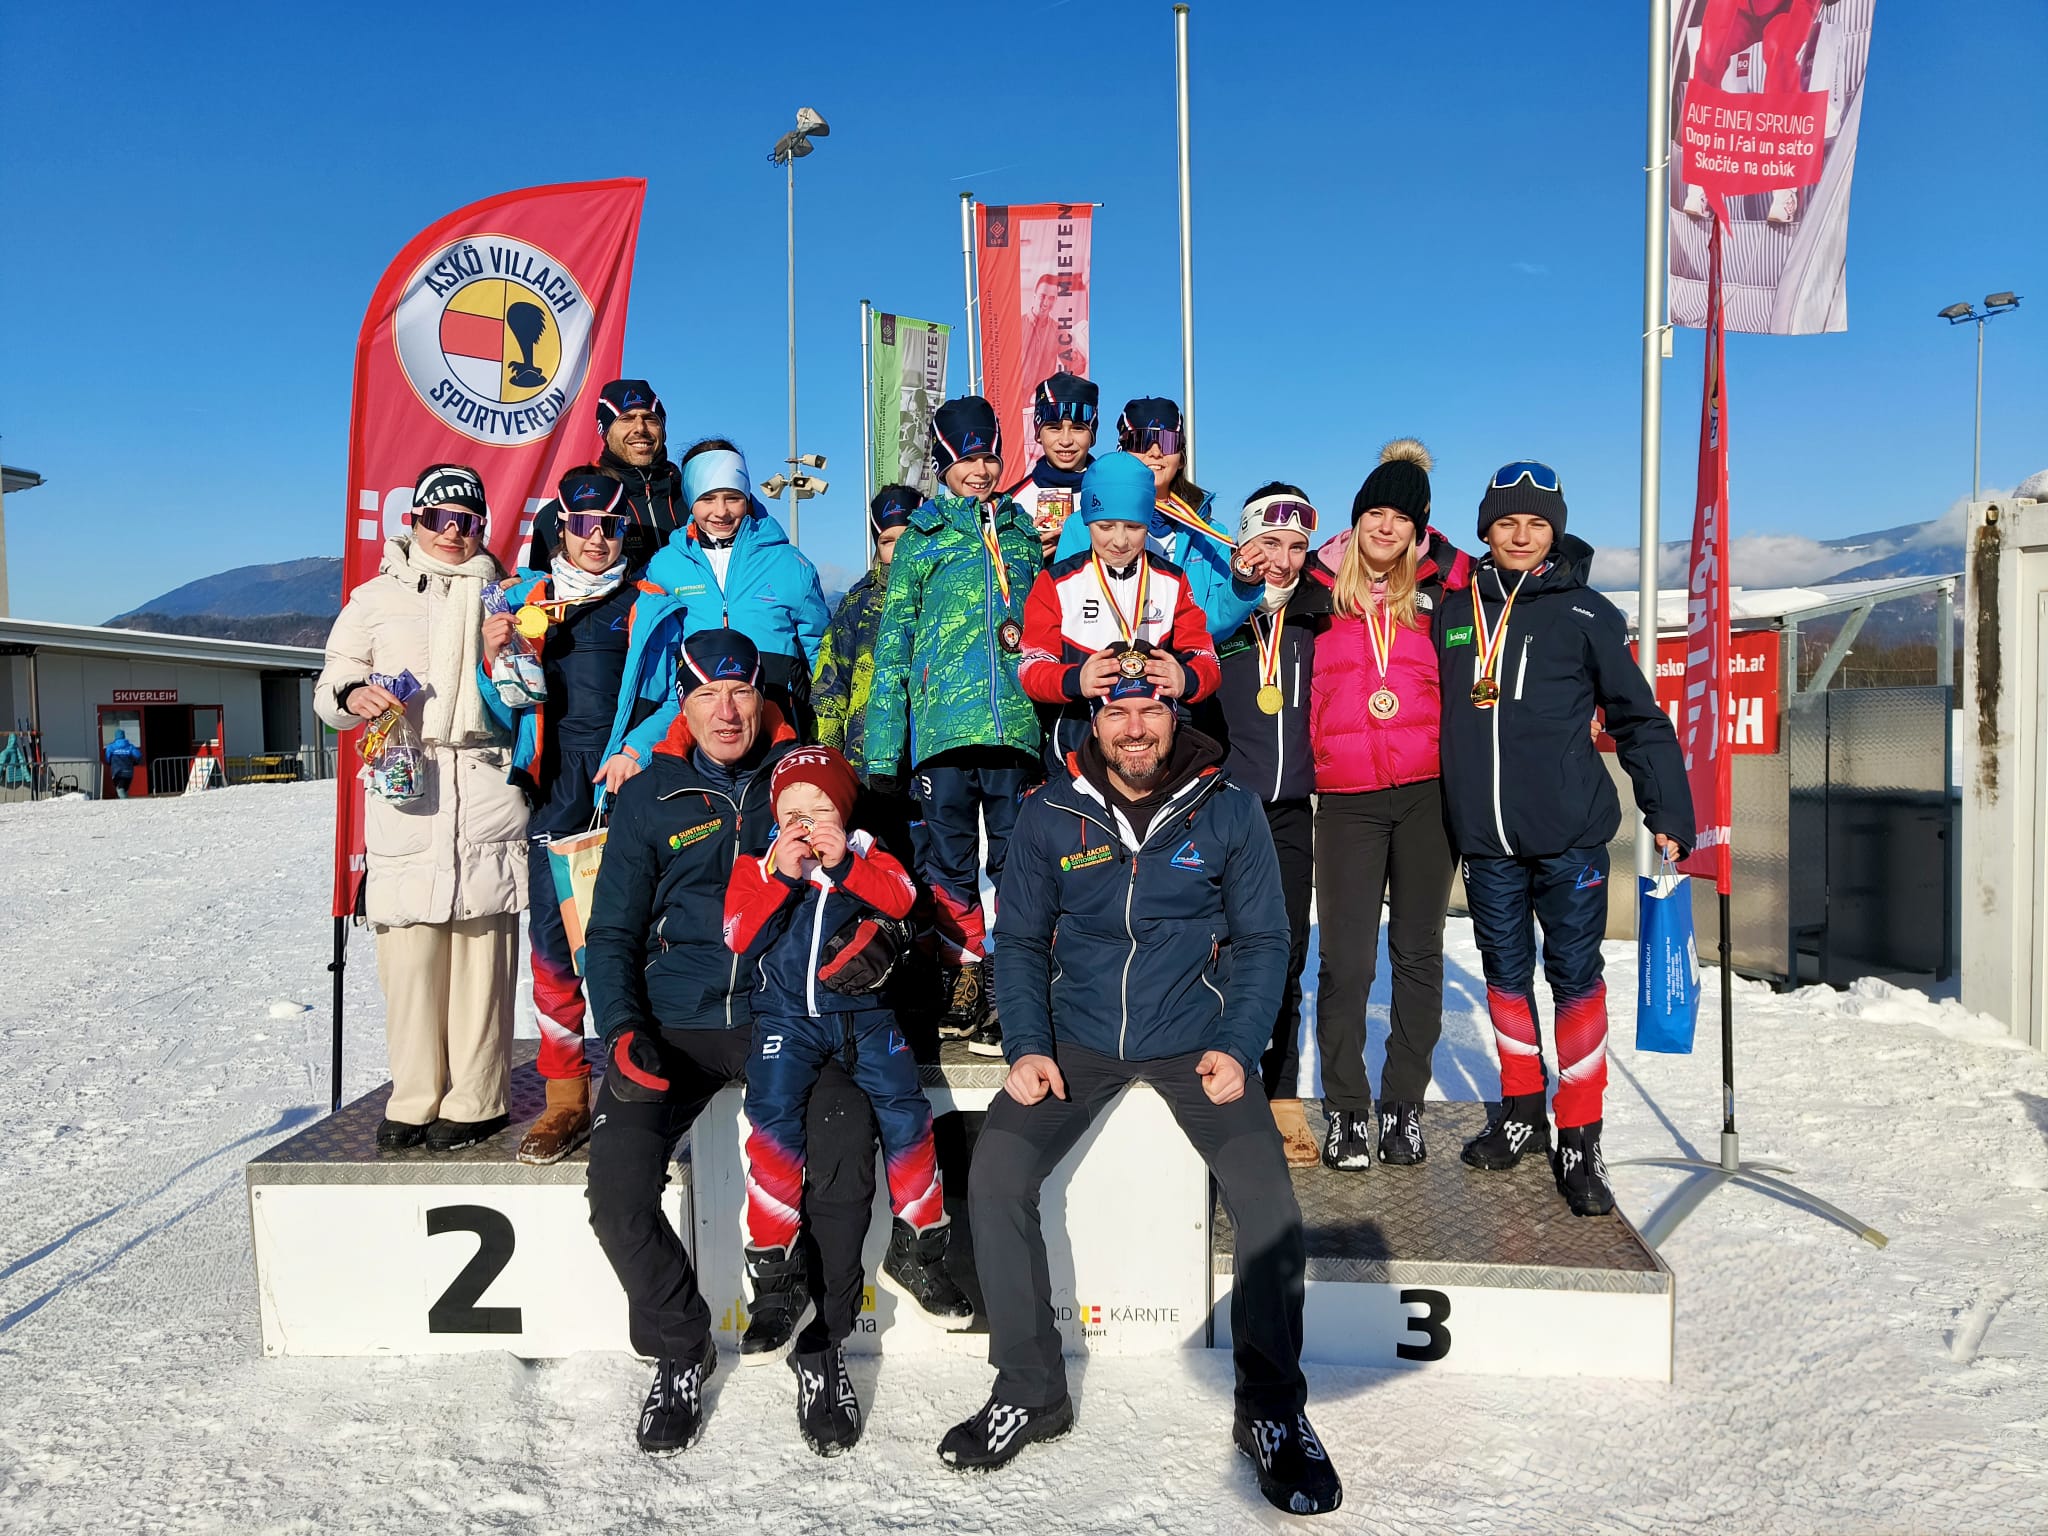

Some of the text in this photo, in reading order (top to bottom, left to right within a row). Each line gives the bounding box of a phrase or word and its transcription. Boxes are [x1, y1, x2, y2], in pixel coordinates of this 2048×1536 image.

[1687, 102, 1815, 135] AUF EINEN SPRUNG
[1685, 126, 1711, 150] Drop
[1713, 132, 1725, 150] in
[1736, 135, 1756, 153] Fai
[1759, 141, 1774, 155] un
[1778, 139, 1814, 156] salto
[1695, 151, 1740, 174] Skočite
[1744, 161, 1758, 175] na
[1057, 205, 1073, 297] MIETEN
[424, 244, 577, 314] ASKÖ VILLACH
[926, 323, 938, 391] MIETEN
[429, 378, 566, 436] SPORTVEREIN
[422, 482, 484, 507] kinfit
[114, 691, 177, 702] SKIVERLEIH
[678, 817, 723, 839] SUNTRACKER
[1069, 844, 1111, 861] SUNRACKER
[426, 1204, 523, 1335] 2
[1081, 1327, 1108, 1338] Sport
[1396, 1289, 1452, 1362] 3
